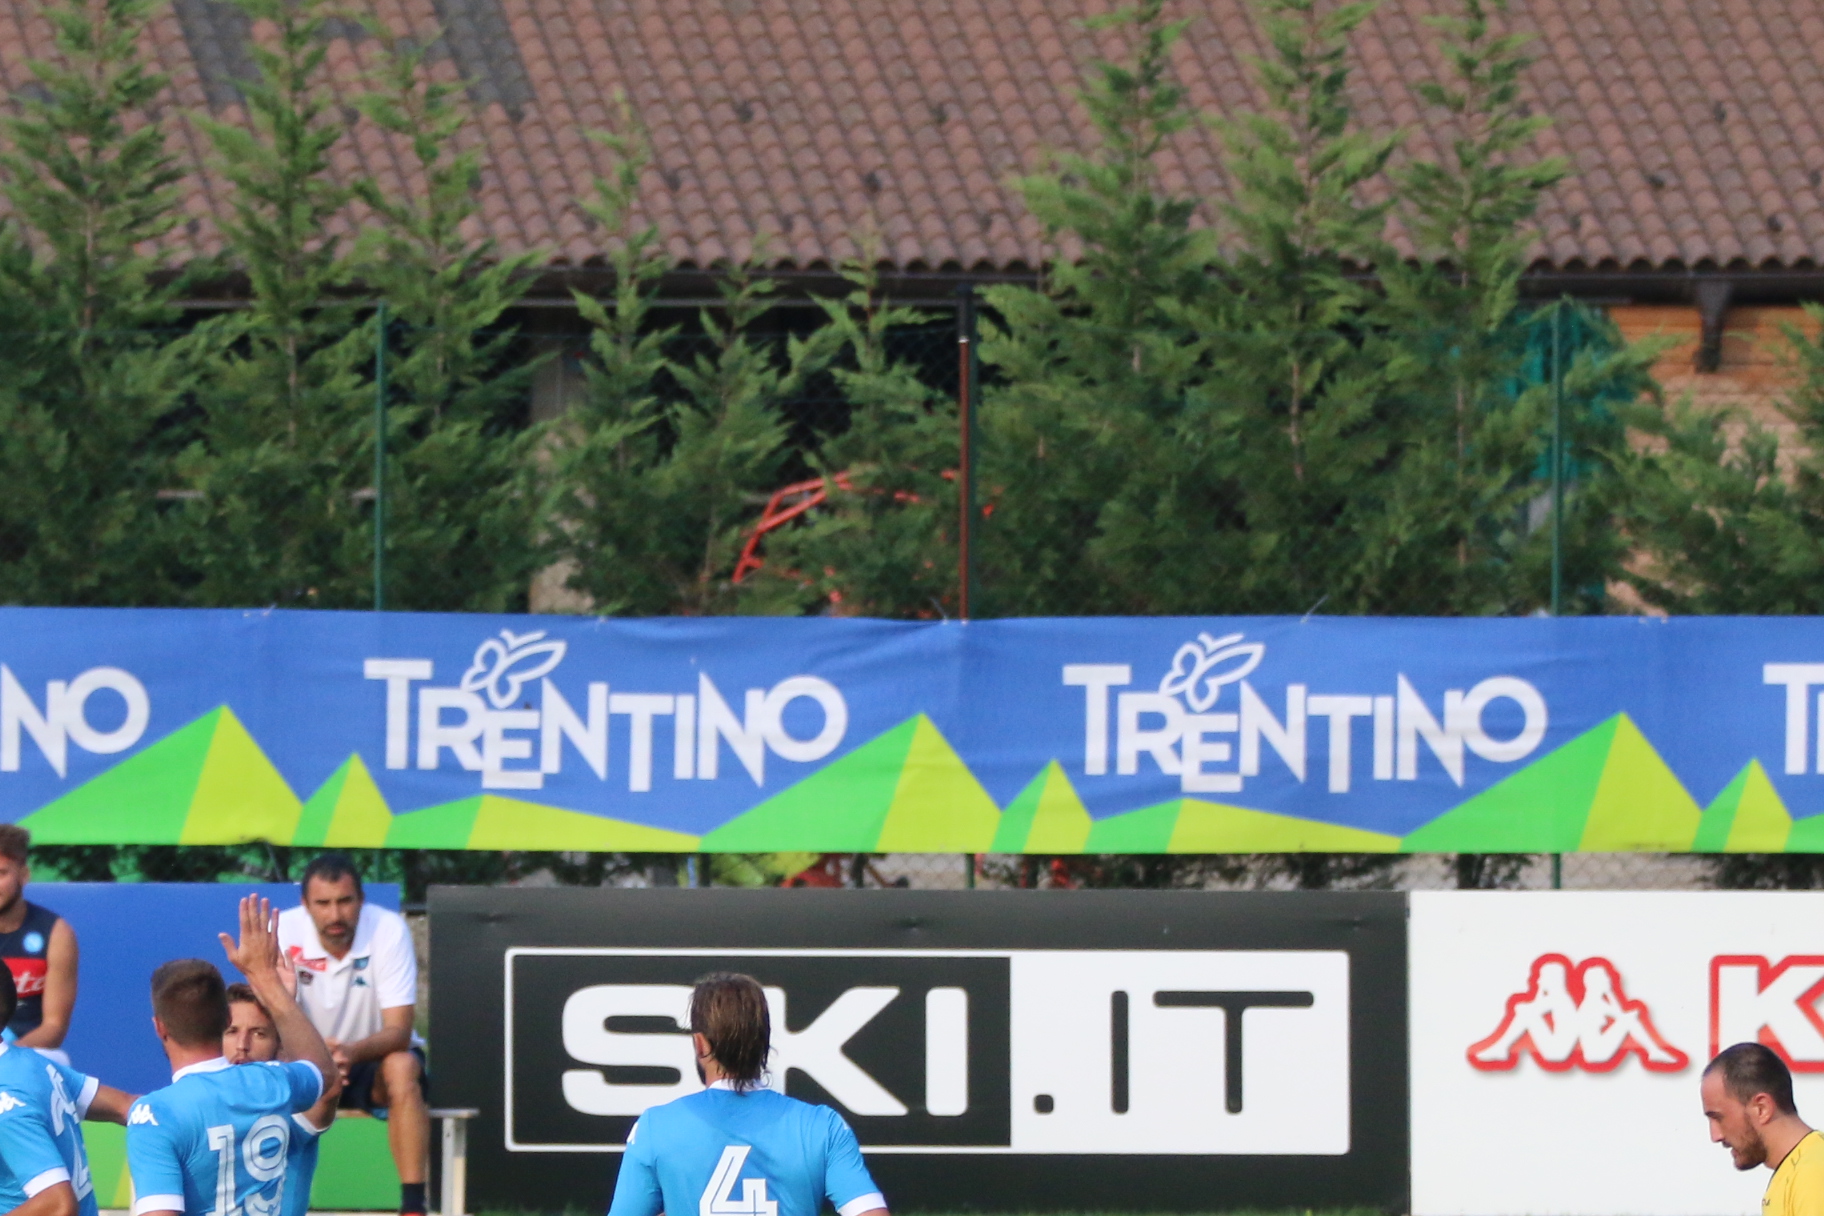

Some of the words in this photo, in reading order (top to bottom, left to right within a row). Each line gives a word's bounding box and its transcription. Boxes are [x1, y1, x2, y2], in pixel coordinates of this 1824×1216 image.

[364, 659, 848, 791] TRENTINO
[1062, 663, 1547, 793] TRENTINO
[562, 984, 1314, 1116] SKI.IT
